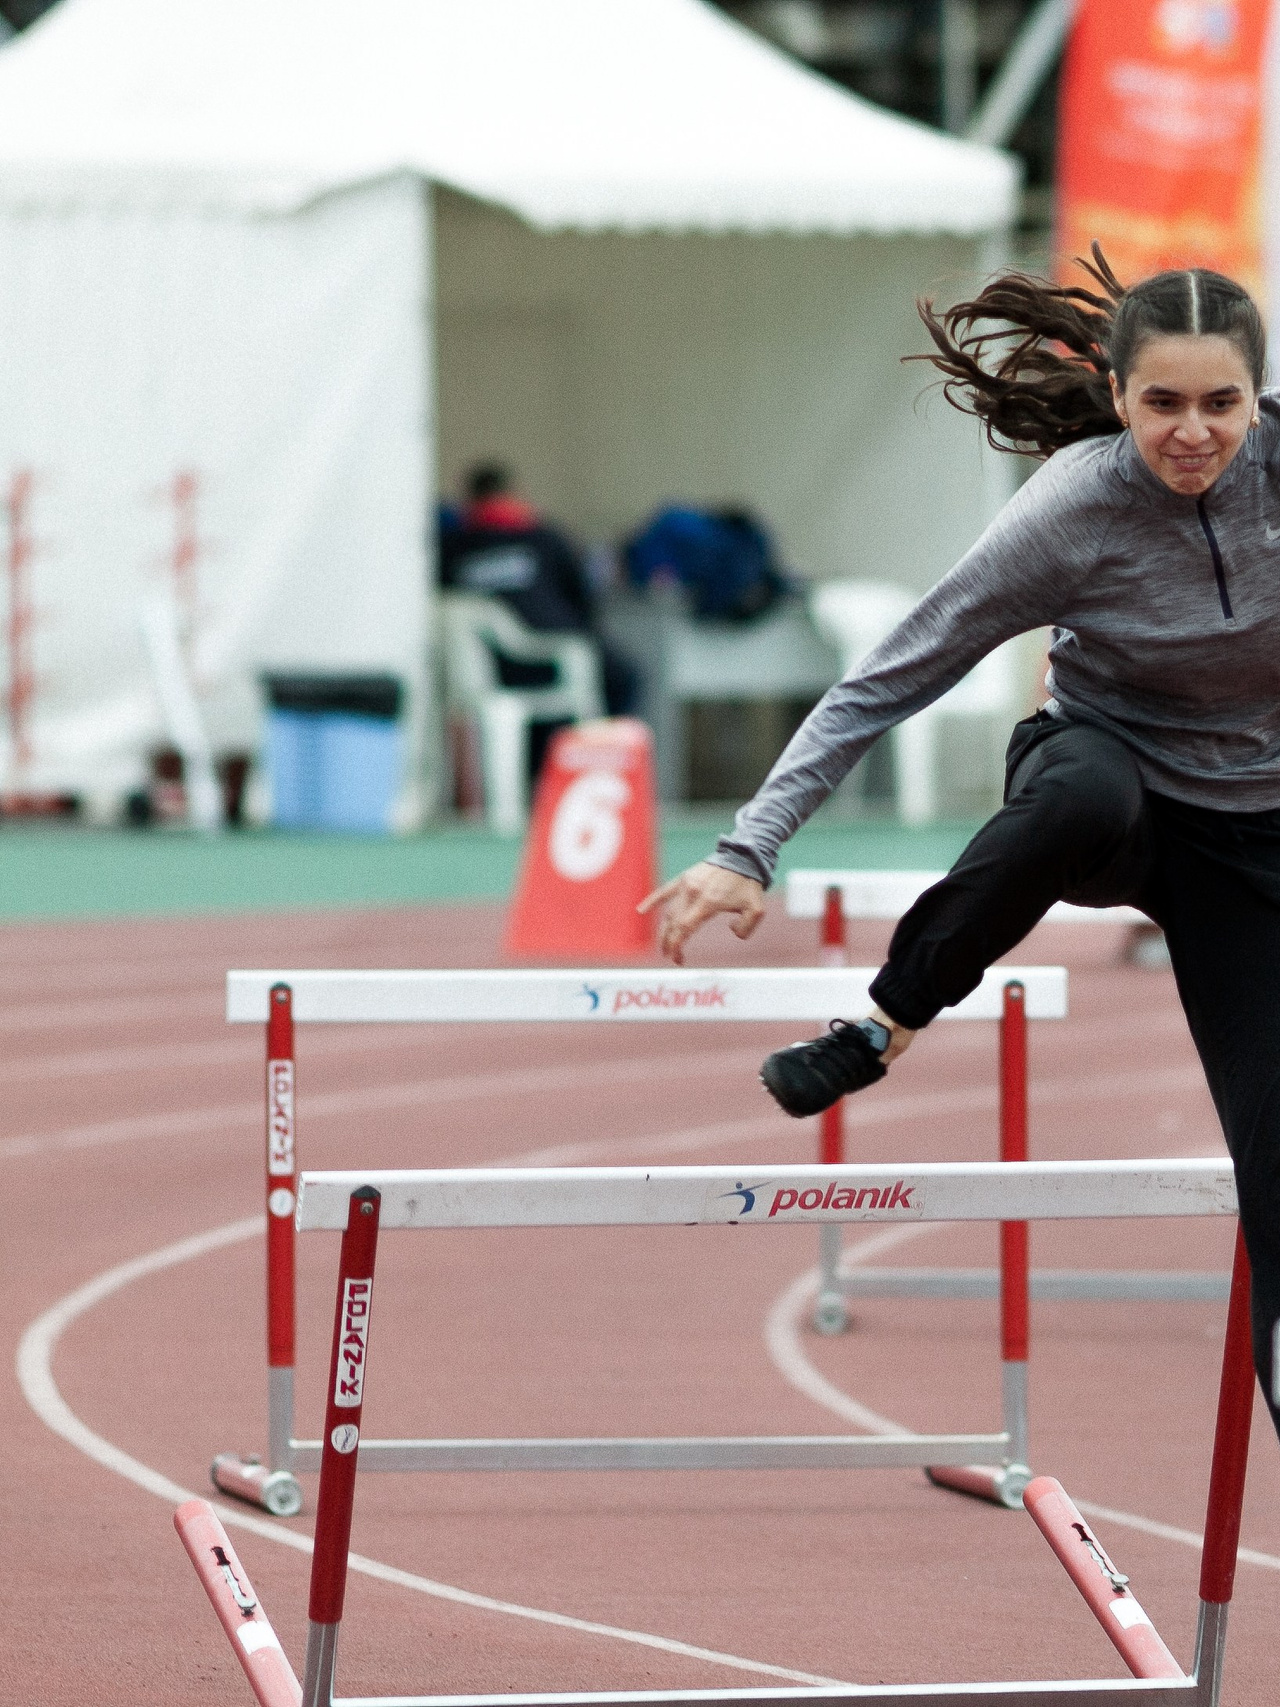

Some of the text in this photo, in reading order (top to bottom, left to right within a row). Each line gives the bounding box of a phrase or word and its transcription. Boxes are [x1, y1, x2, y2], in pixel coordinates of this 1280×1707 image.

[549, 770, 632, 882] 6
[612, 983, 727, 1015] polanik
[768, 1181, 915, 1218] polanik
[340, 1283, 368, 1396] POLANIK
